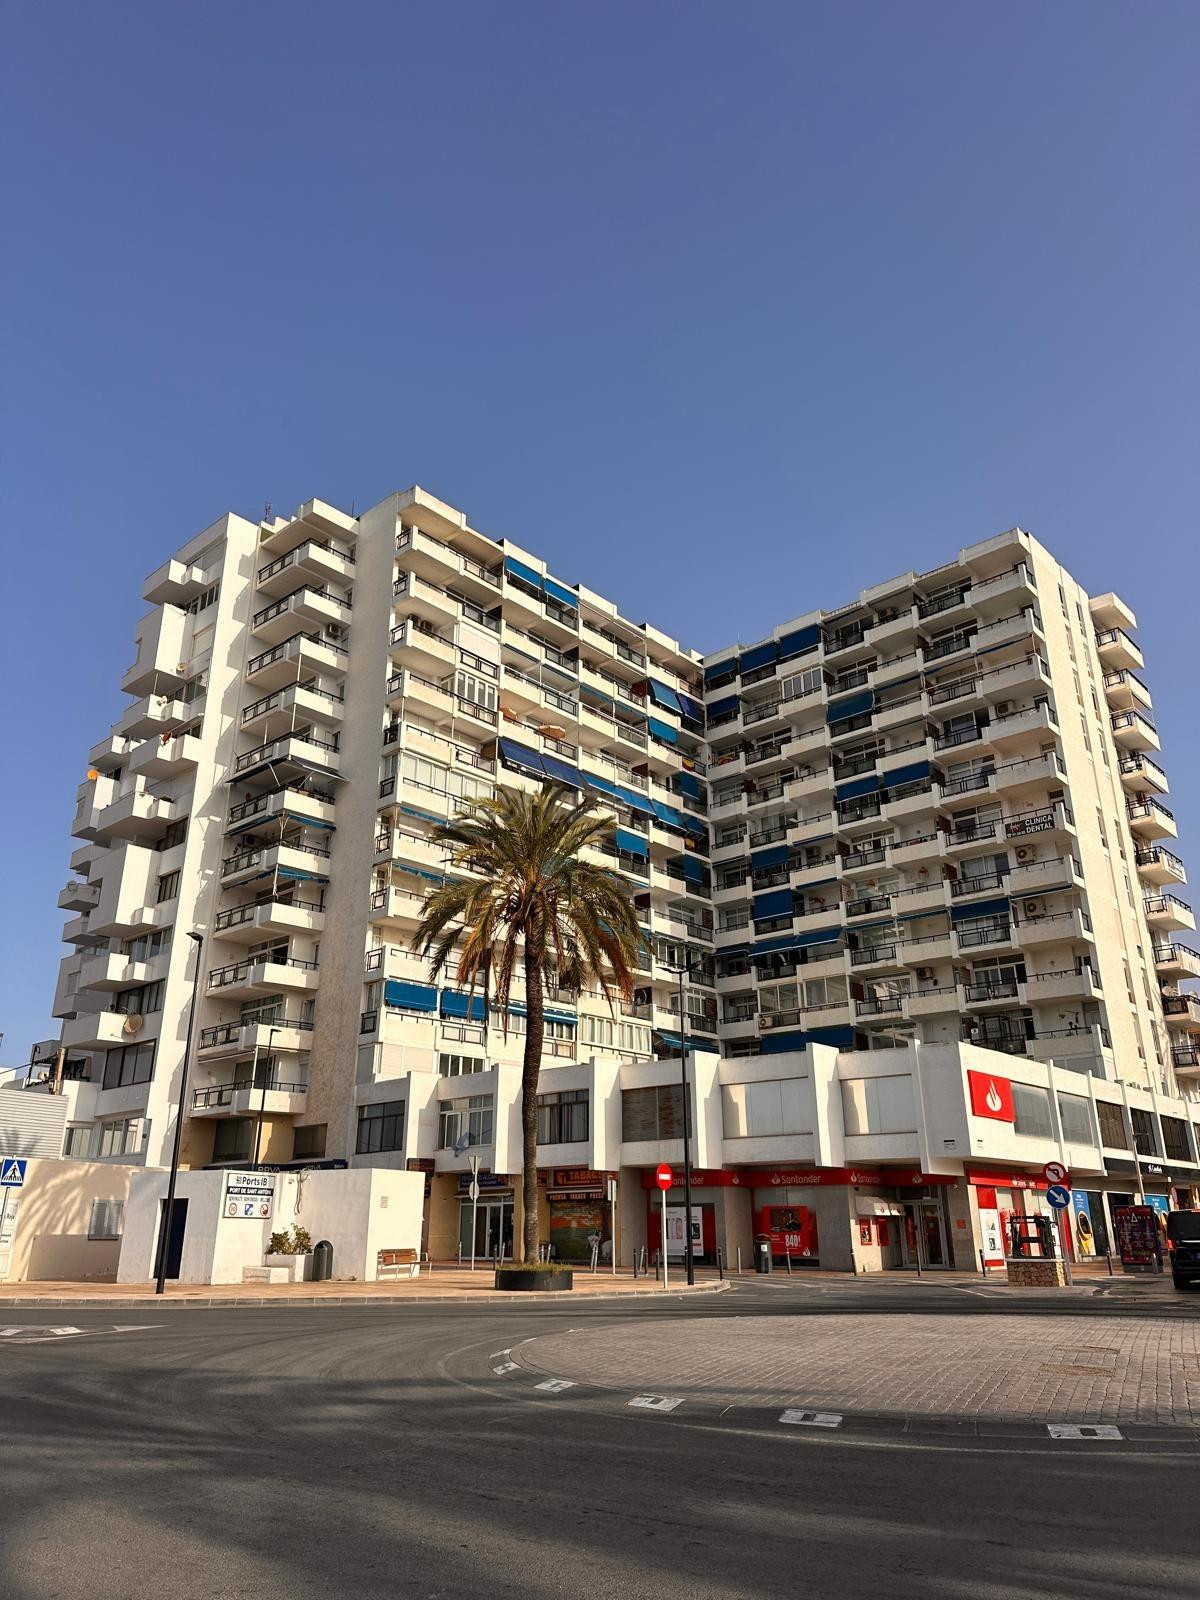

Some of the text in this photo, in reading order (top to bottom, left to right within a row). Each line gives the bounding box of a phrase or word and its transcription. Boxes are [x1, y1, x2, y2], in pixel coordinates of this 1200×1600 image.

[1025, 815, 1052, 826] CLINICA
[1026, 822, 1053, 834] DENTAL
[781, 1175, 822, 1184] Santander
